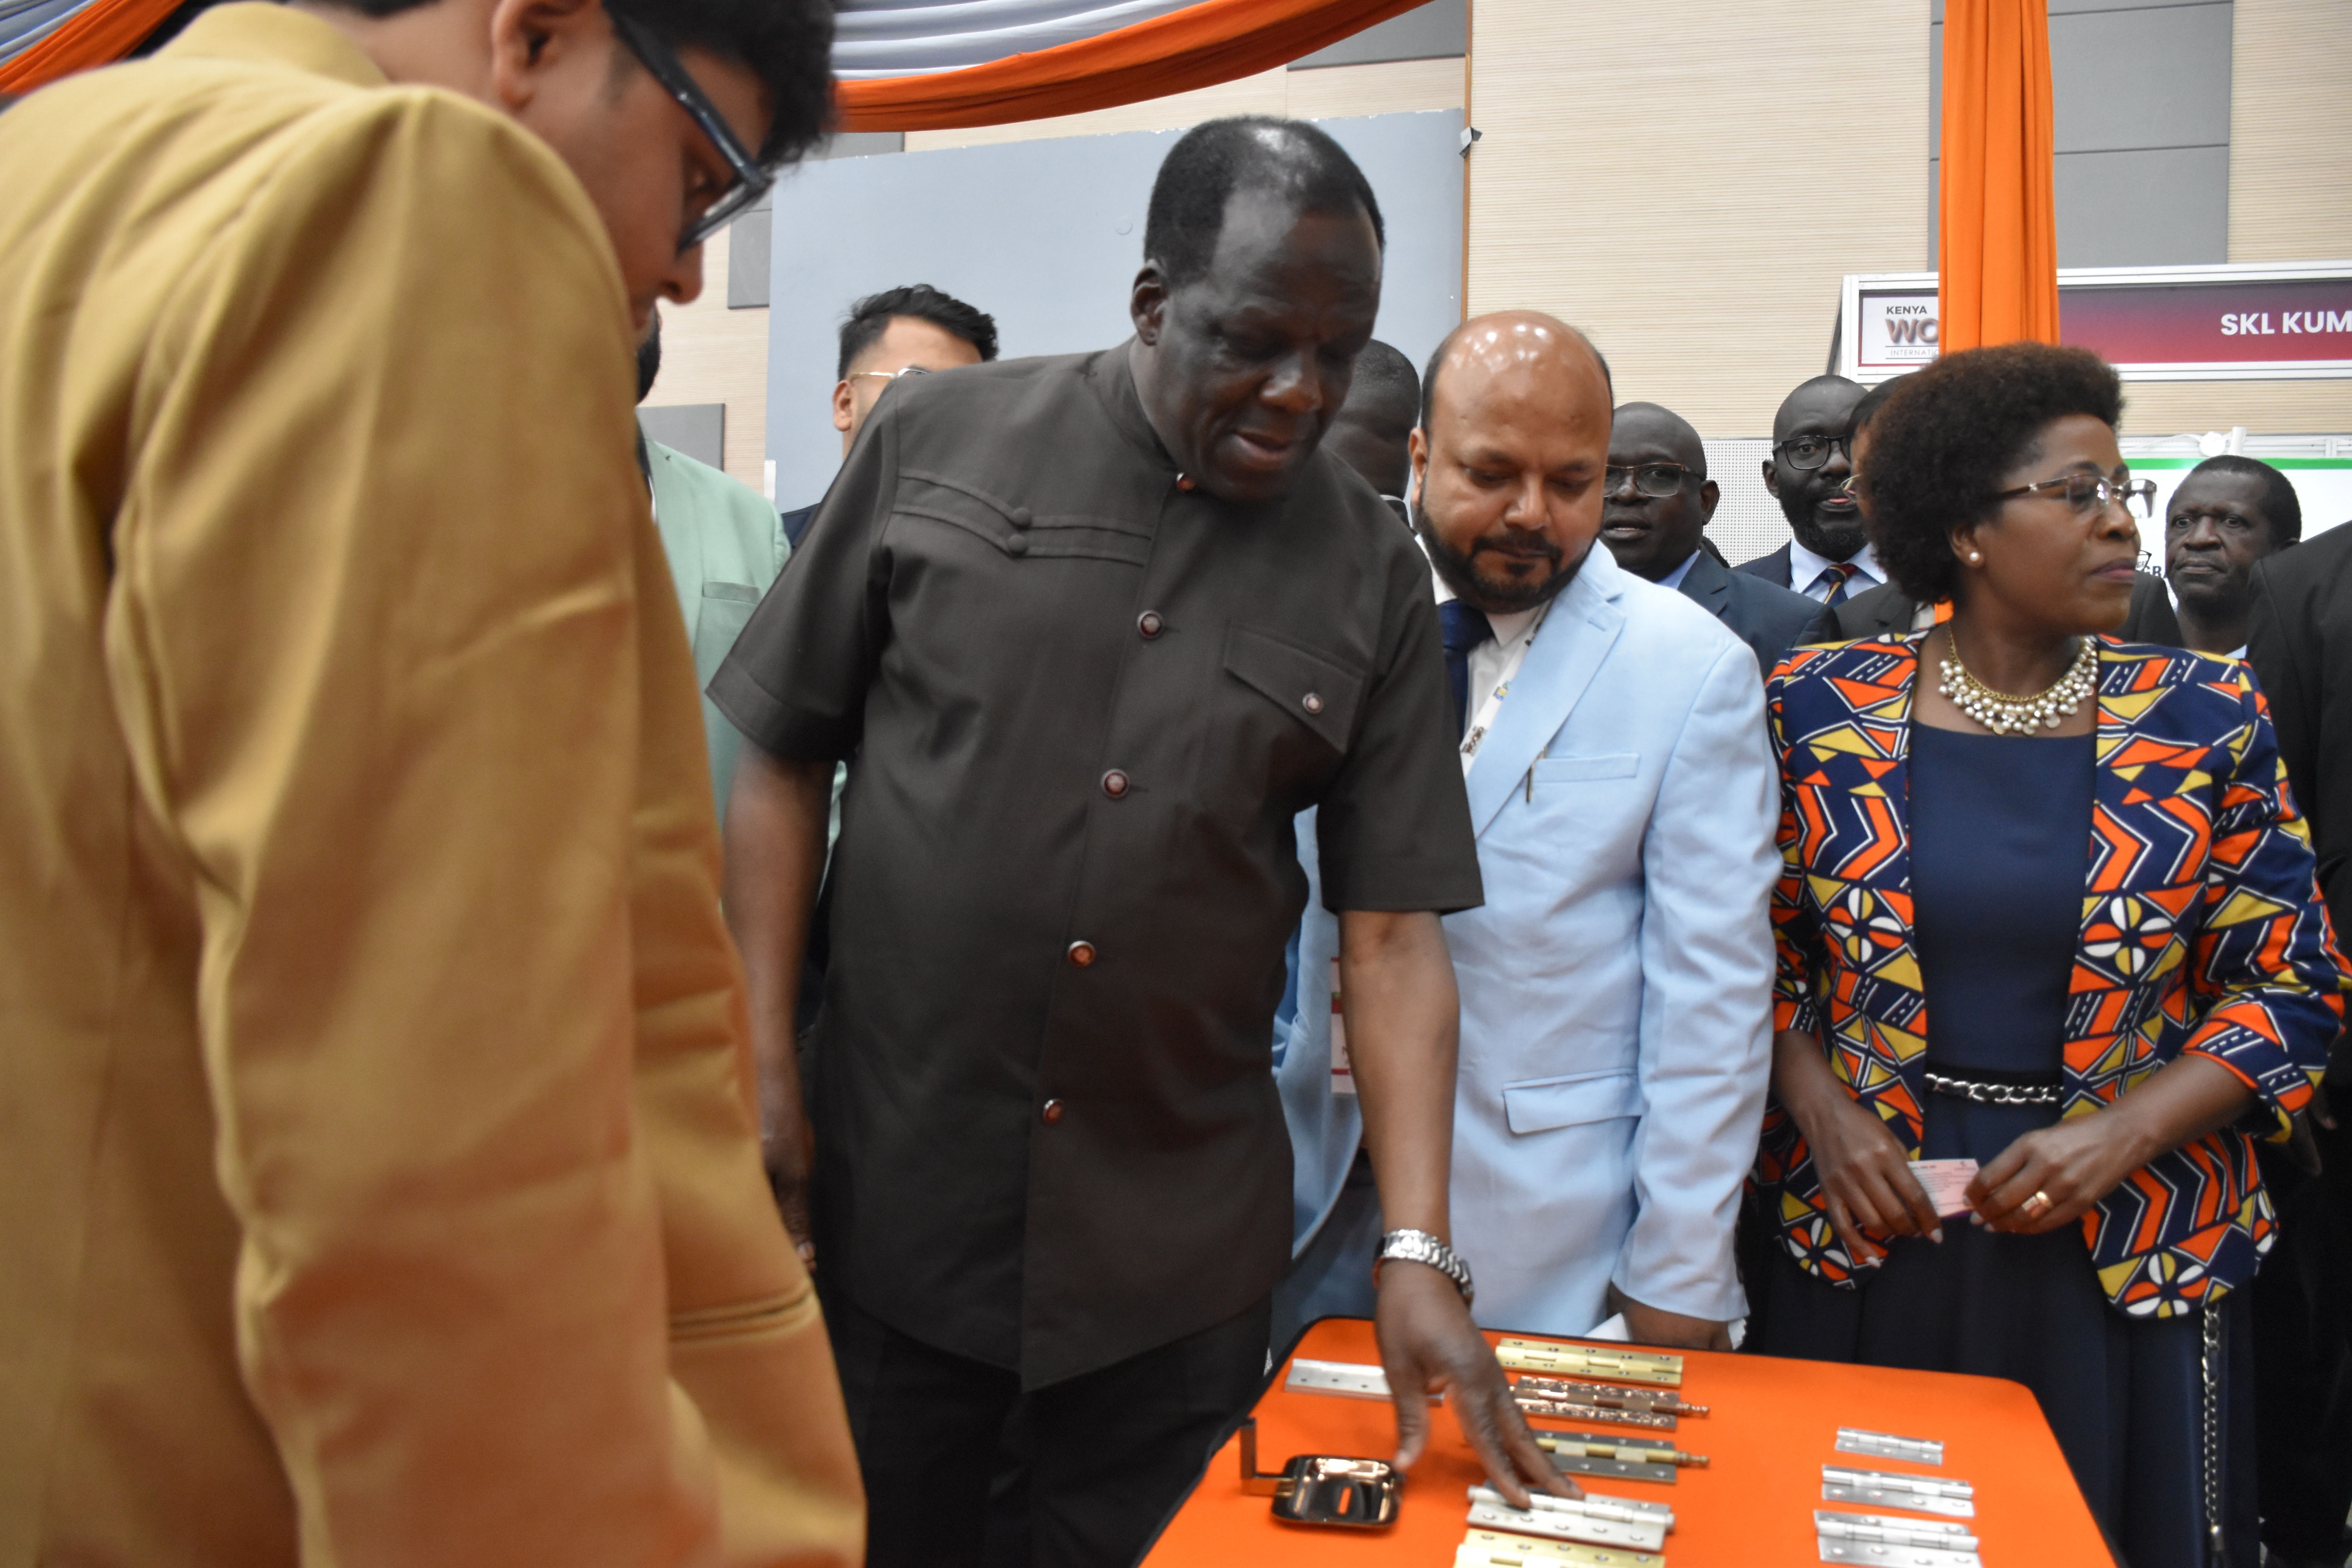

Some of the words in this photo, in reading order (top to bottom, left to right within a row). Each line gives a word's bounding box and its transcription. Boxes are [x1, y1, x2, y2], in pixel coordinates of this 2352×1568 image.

[1886, 306, 1927, 314] KENYA
[2221, 313, 2275, 336] SKL
[2282, 310, 2352, 334] KUM
[1885, 318, 1939, 344] WO
